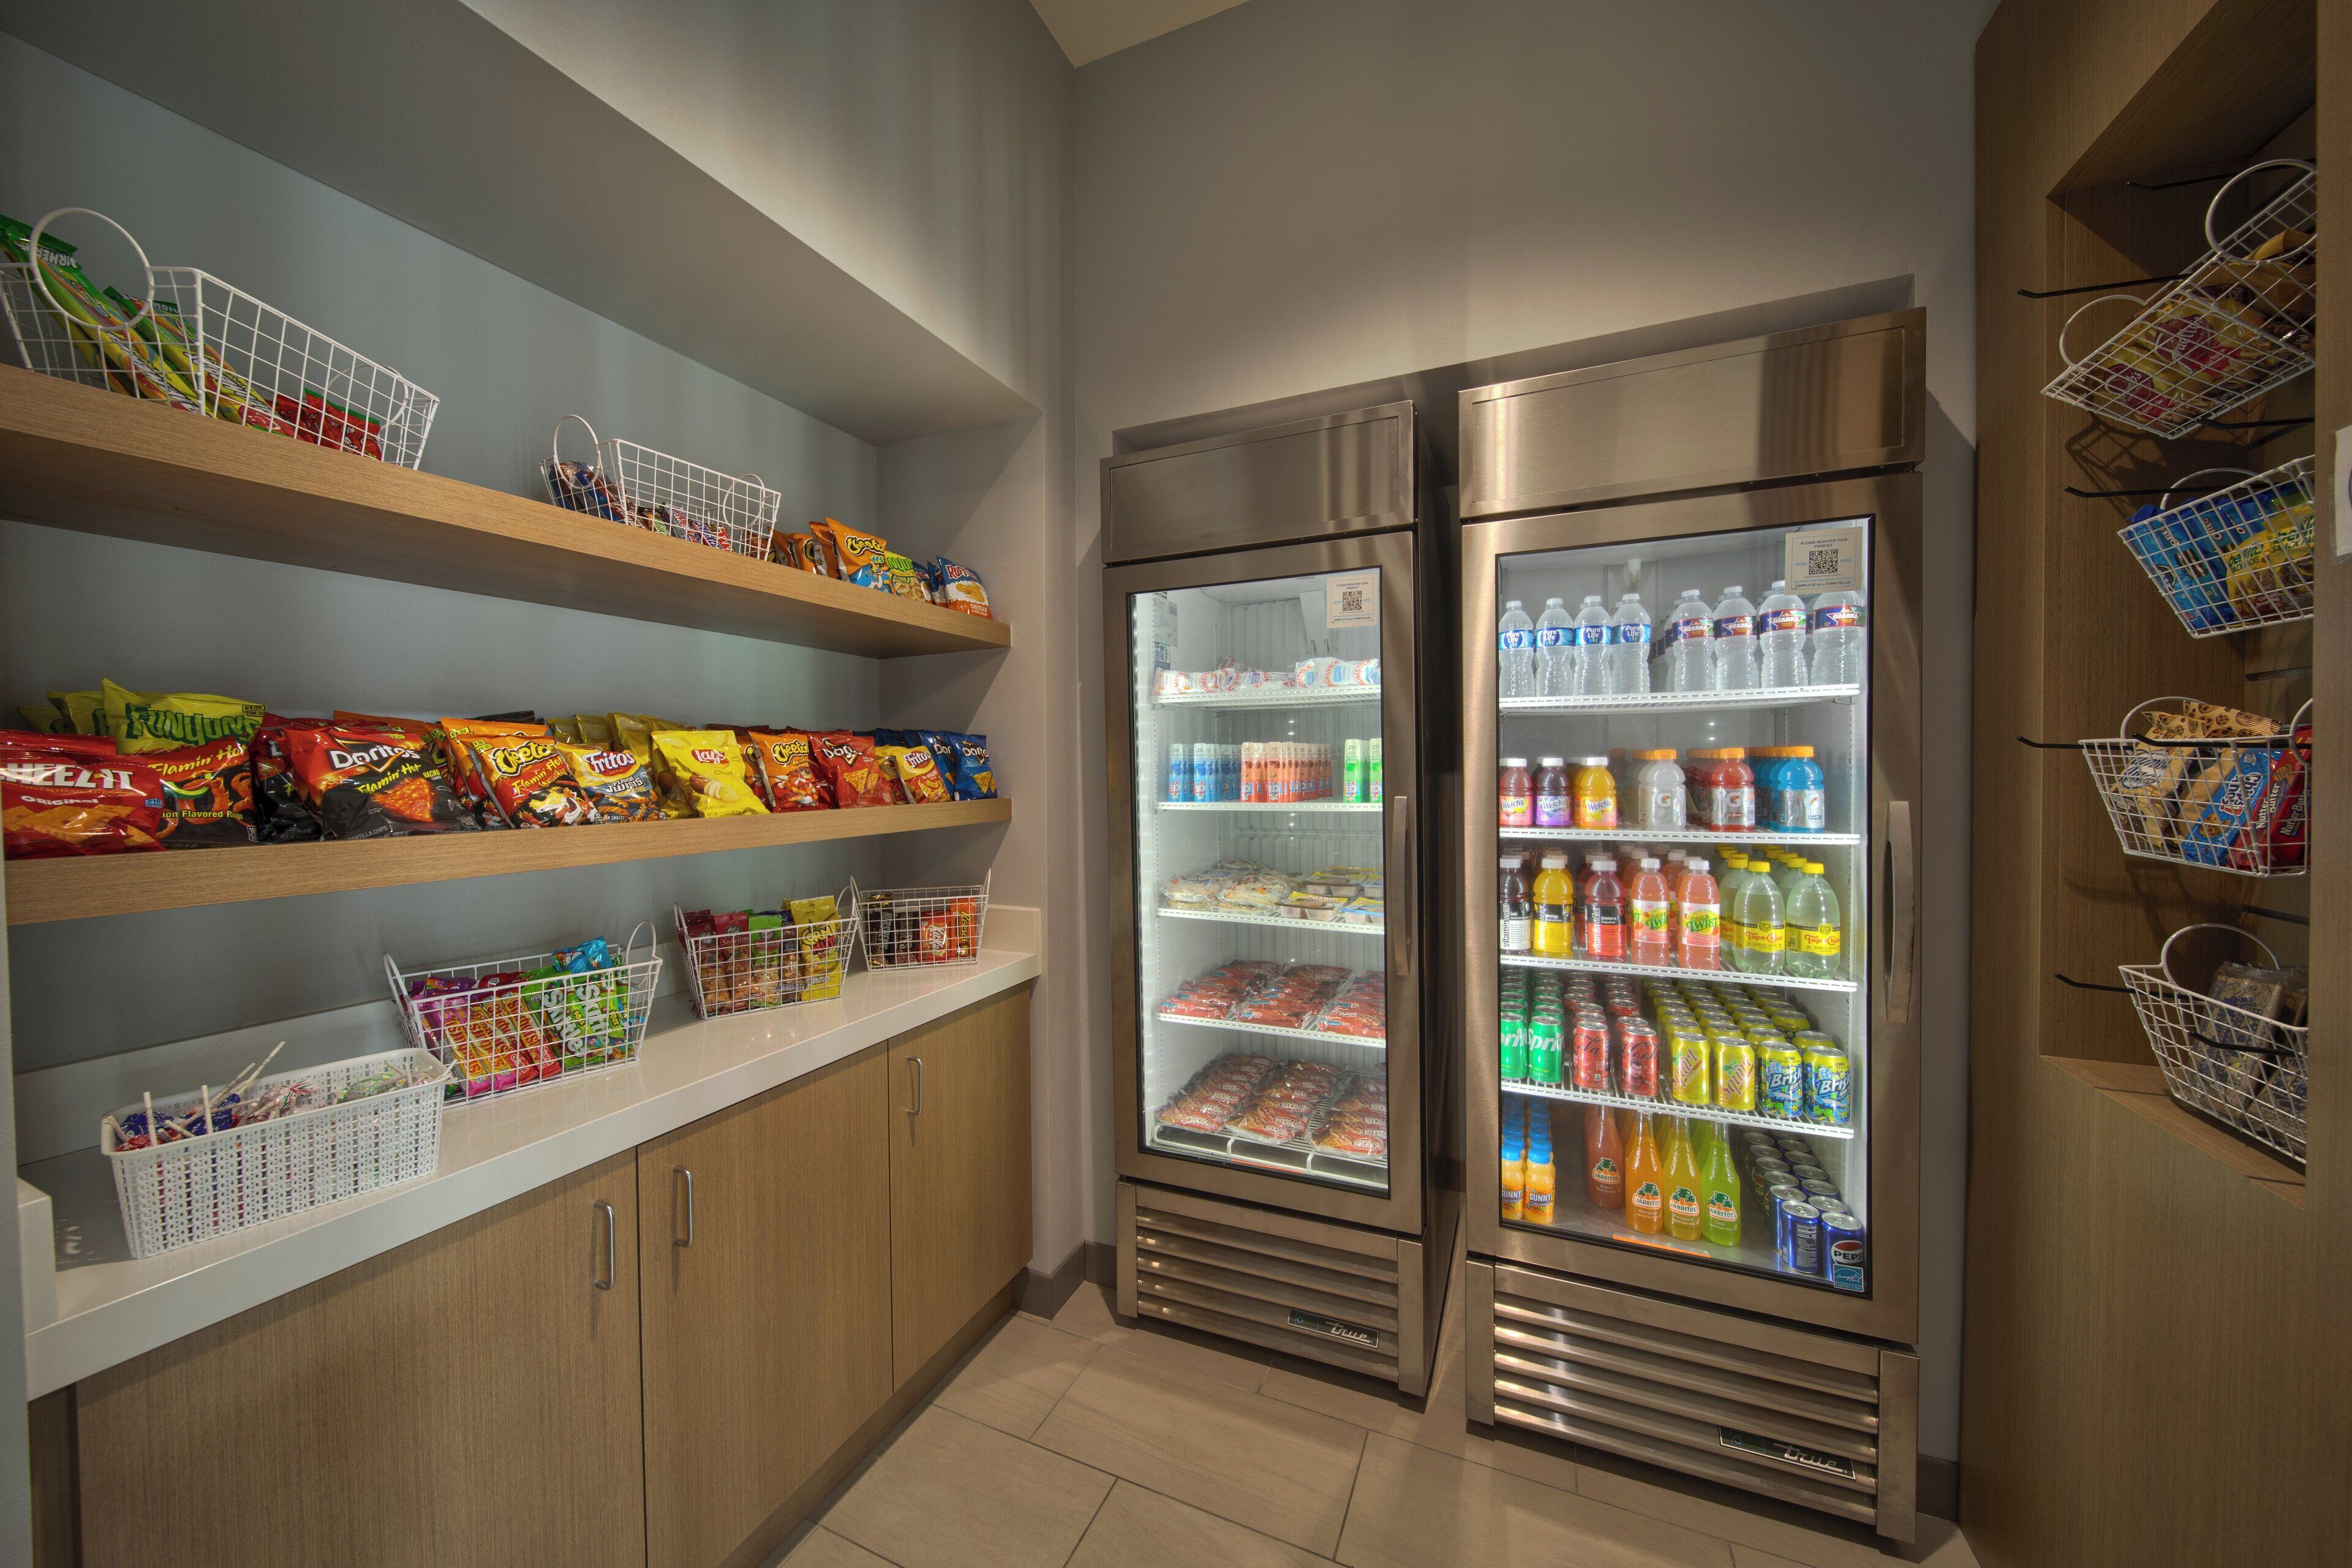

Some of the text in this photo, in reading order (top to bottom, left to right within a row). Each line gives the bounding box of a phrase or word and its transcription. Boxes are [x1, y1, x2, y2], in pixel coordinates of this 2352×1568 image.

[2203, 518, 2223, 541] OREO
[216, 745, 247, 761] Hot
[329, 745, 421, 769] Doritos
[695, 750, 726, 764] Lay's
[903, 751, 932, 769] Fritos
[546, 756, 563, 771] Hot
[582, 750, 636, 774] Fritos
[0, 763, 96, 788] HEEZ
[356, 763, 421, 794] Flamin' Hot
[423, 769, 440, 778] NACHO
[606, 777, 643, 793] TWISTS
[612, 777, 635, 786] FLAVOR
[1502, 799, 1524, 809] Welch's
[1542, 799, 1566, 810] Welch's
[1588, 799, 1611, 810] Welch's
[227, 810, 243, 820] Rings
[1746, 932, 1783, 943] Topo Chico
[1804, 935, 1824, 944] Topo
[1673, 1048, 1698, 1090] Squirt
[1721, 1054, 1752, 1099] Squirt
[1594, 1172, 1618, 1181] JARRITOS
[1529, 1193, 1551, 1202] SUNNY
[1671, 1204, 1697, 1213] JARRITOS
[1707, 1207, 1734, 1218] JARRITOS
[1326, 1321, 1371, 1343] true
[1774, 1443, 1843, 1472] true
